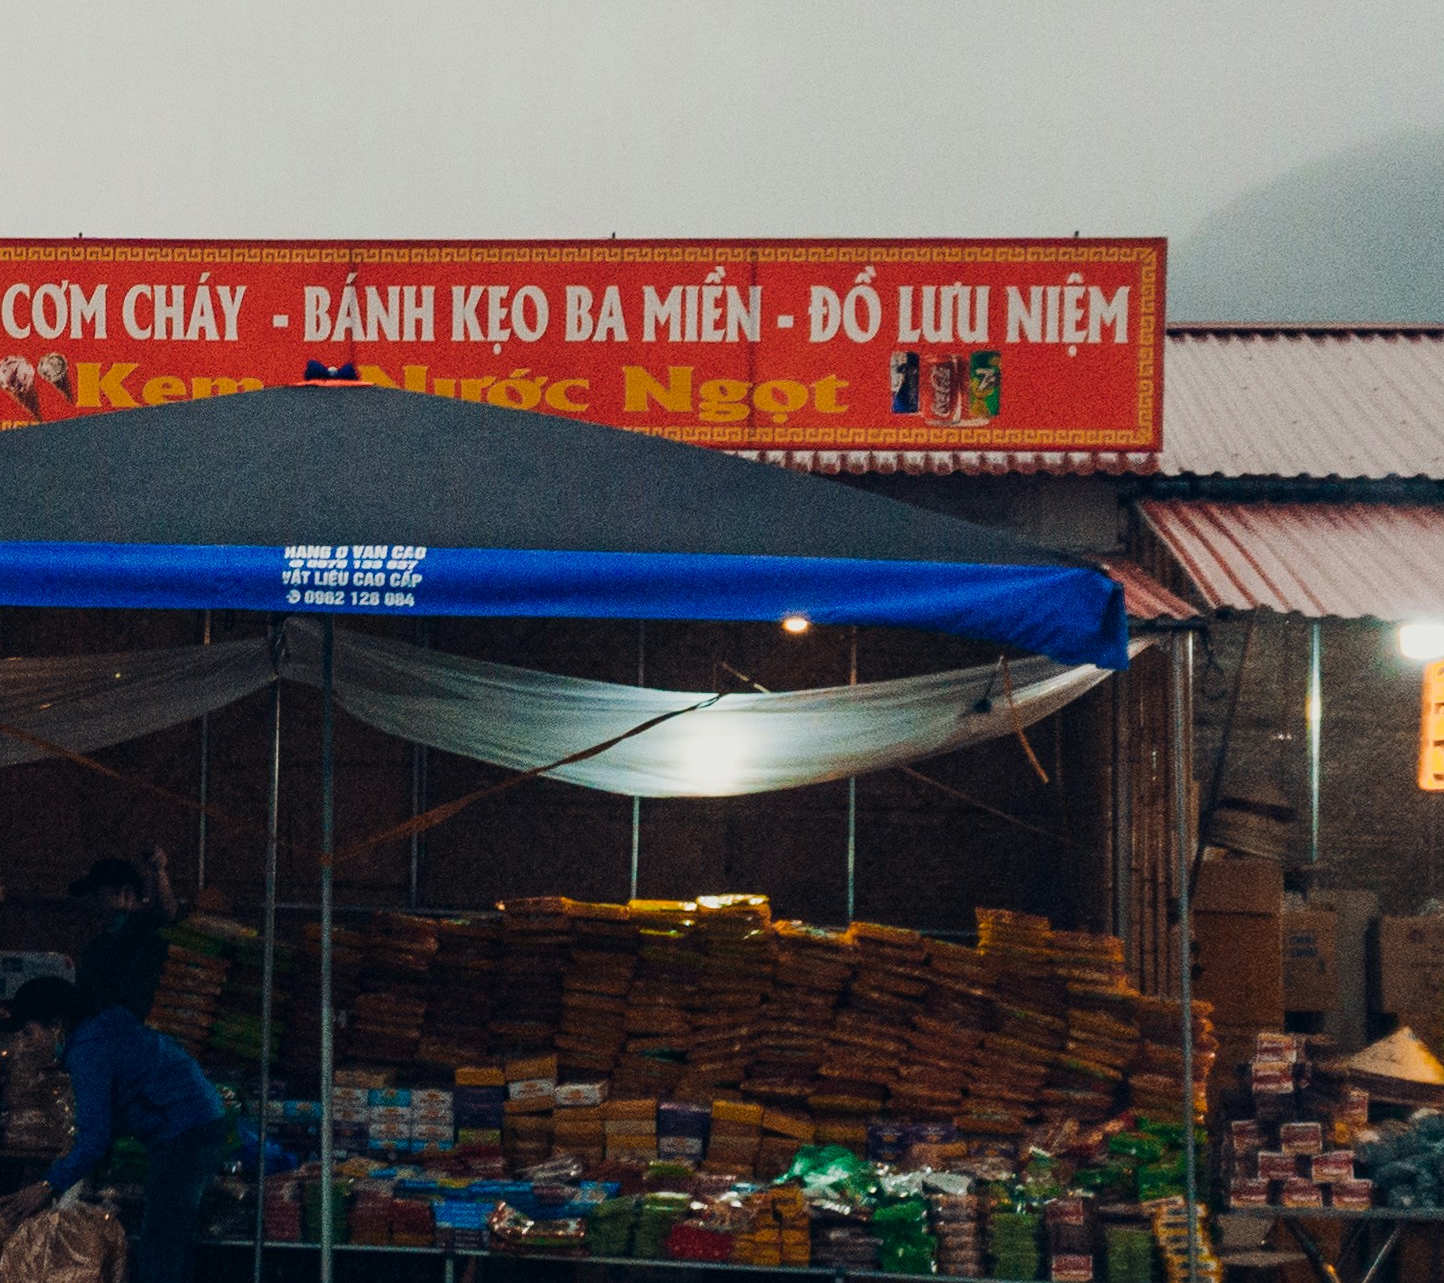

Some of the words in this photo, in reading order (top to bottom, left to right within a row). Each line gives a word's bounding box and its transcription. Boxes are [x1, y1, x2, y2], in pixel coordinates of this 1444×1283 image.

[1, 278, 109, 340] CƠM
[122, 272, 248, 342] CHÁY
[304, 272, 435, 342] BÁNH
[451, 285, 550, 355] KẸO
[565, 285, 629, 343] BA
[643, 266, 763, 343] MIỀN
[808, 265, 882, 344] ĐỒ
[897, 281, 991, 344] LƯU
[1005, 272, 1131, 357] NIỆM
[622, 365, 849, 424] Ngọt
[353, 571, 386, 587] CAO
